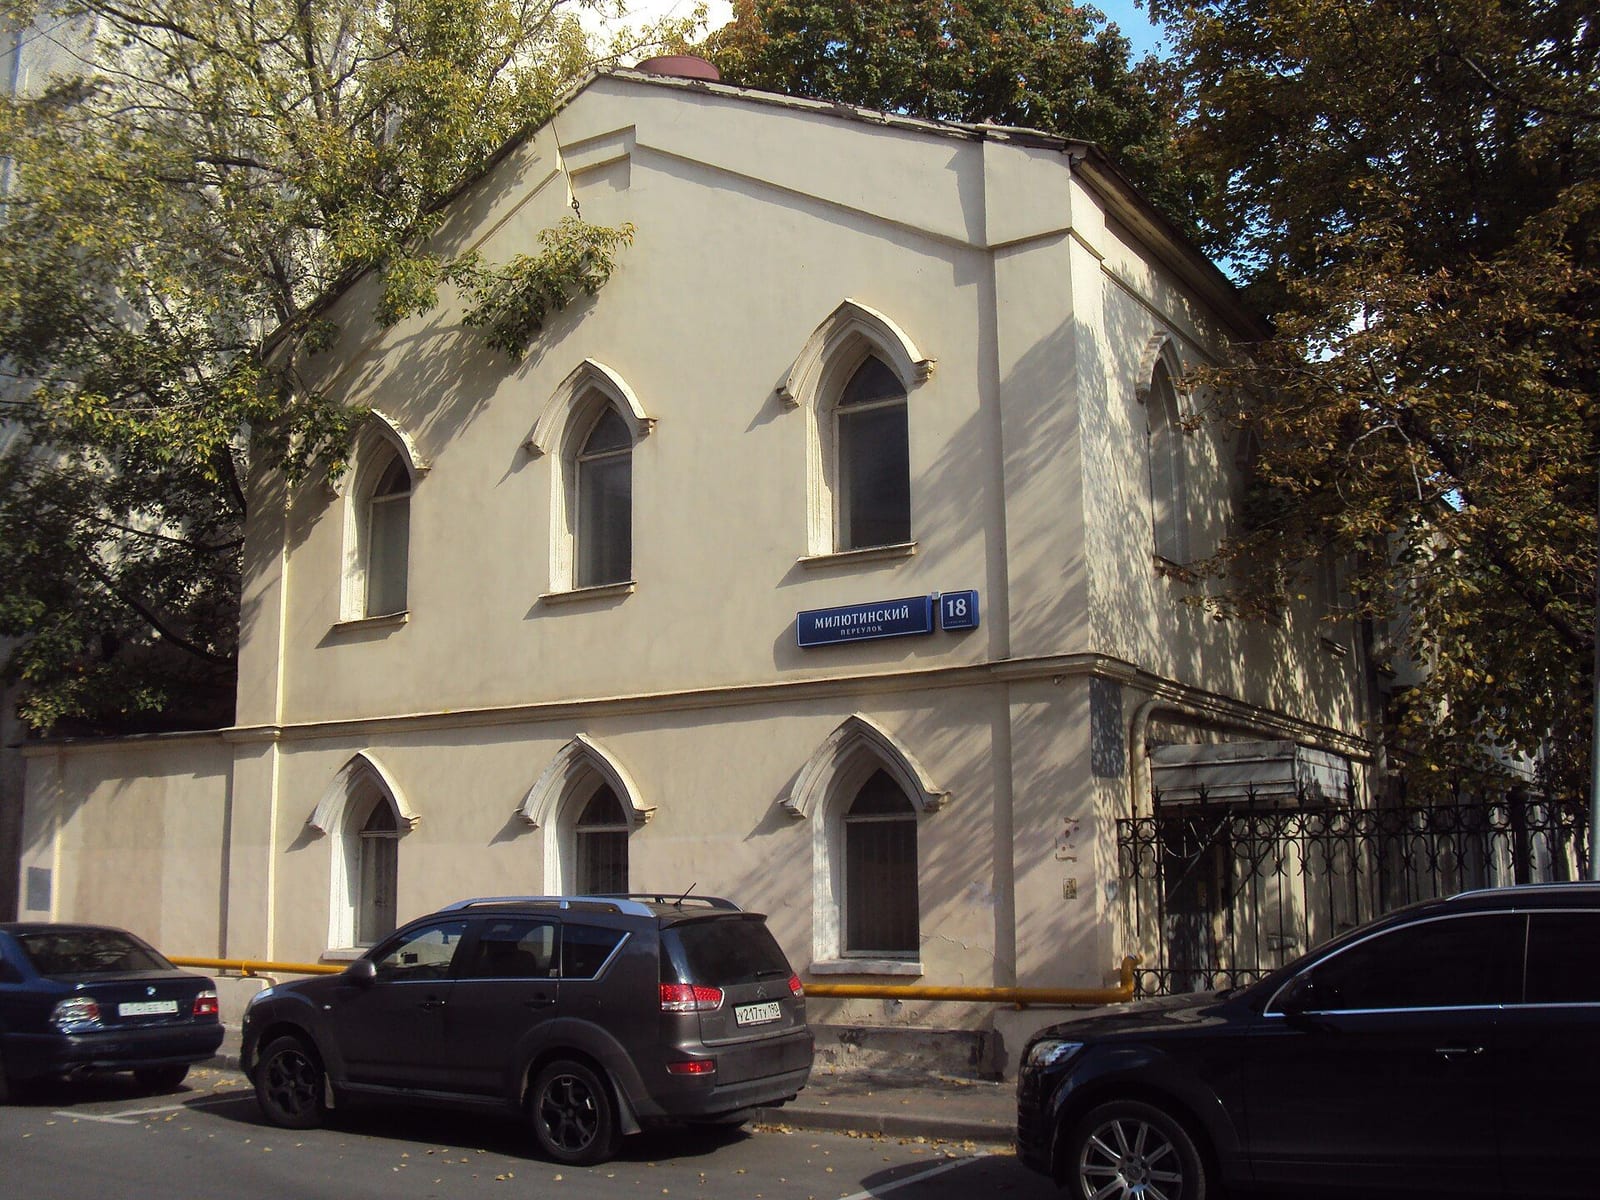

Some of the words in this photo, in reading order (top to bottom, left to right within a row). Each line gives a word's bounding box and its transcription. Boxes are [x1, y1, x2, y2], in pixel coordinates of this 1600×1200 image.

[947, 598, 967, 617] 18
[814, 605, 910, 630] МИЛЮТИНСКИЙ
[840, 625, 883, 636] ПЕРЕУЛОК
